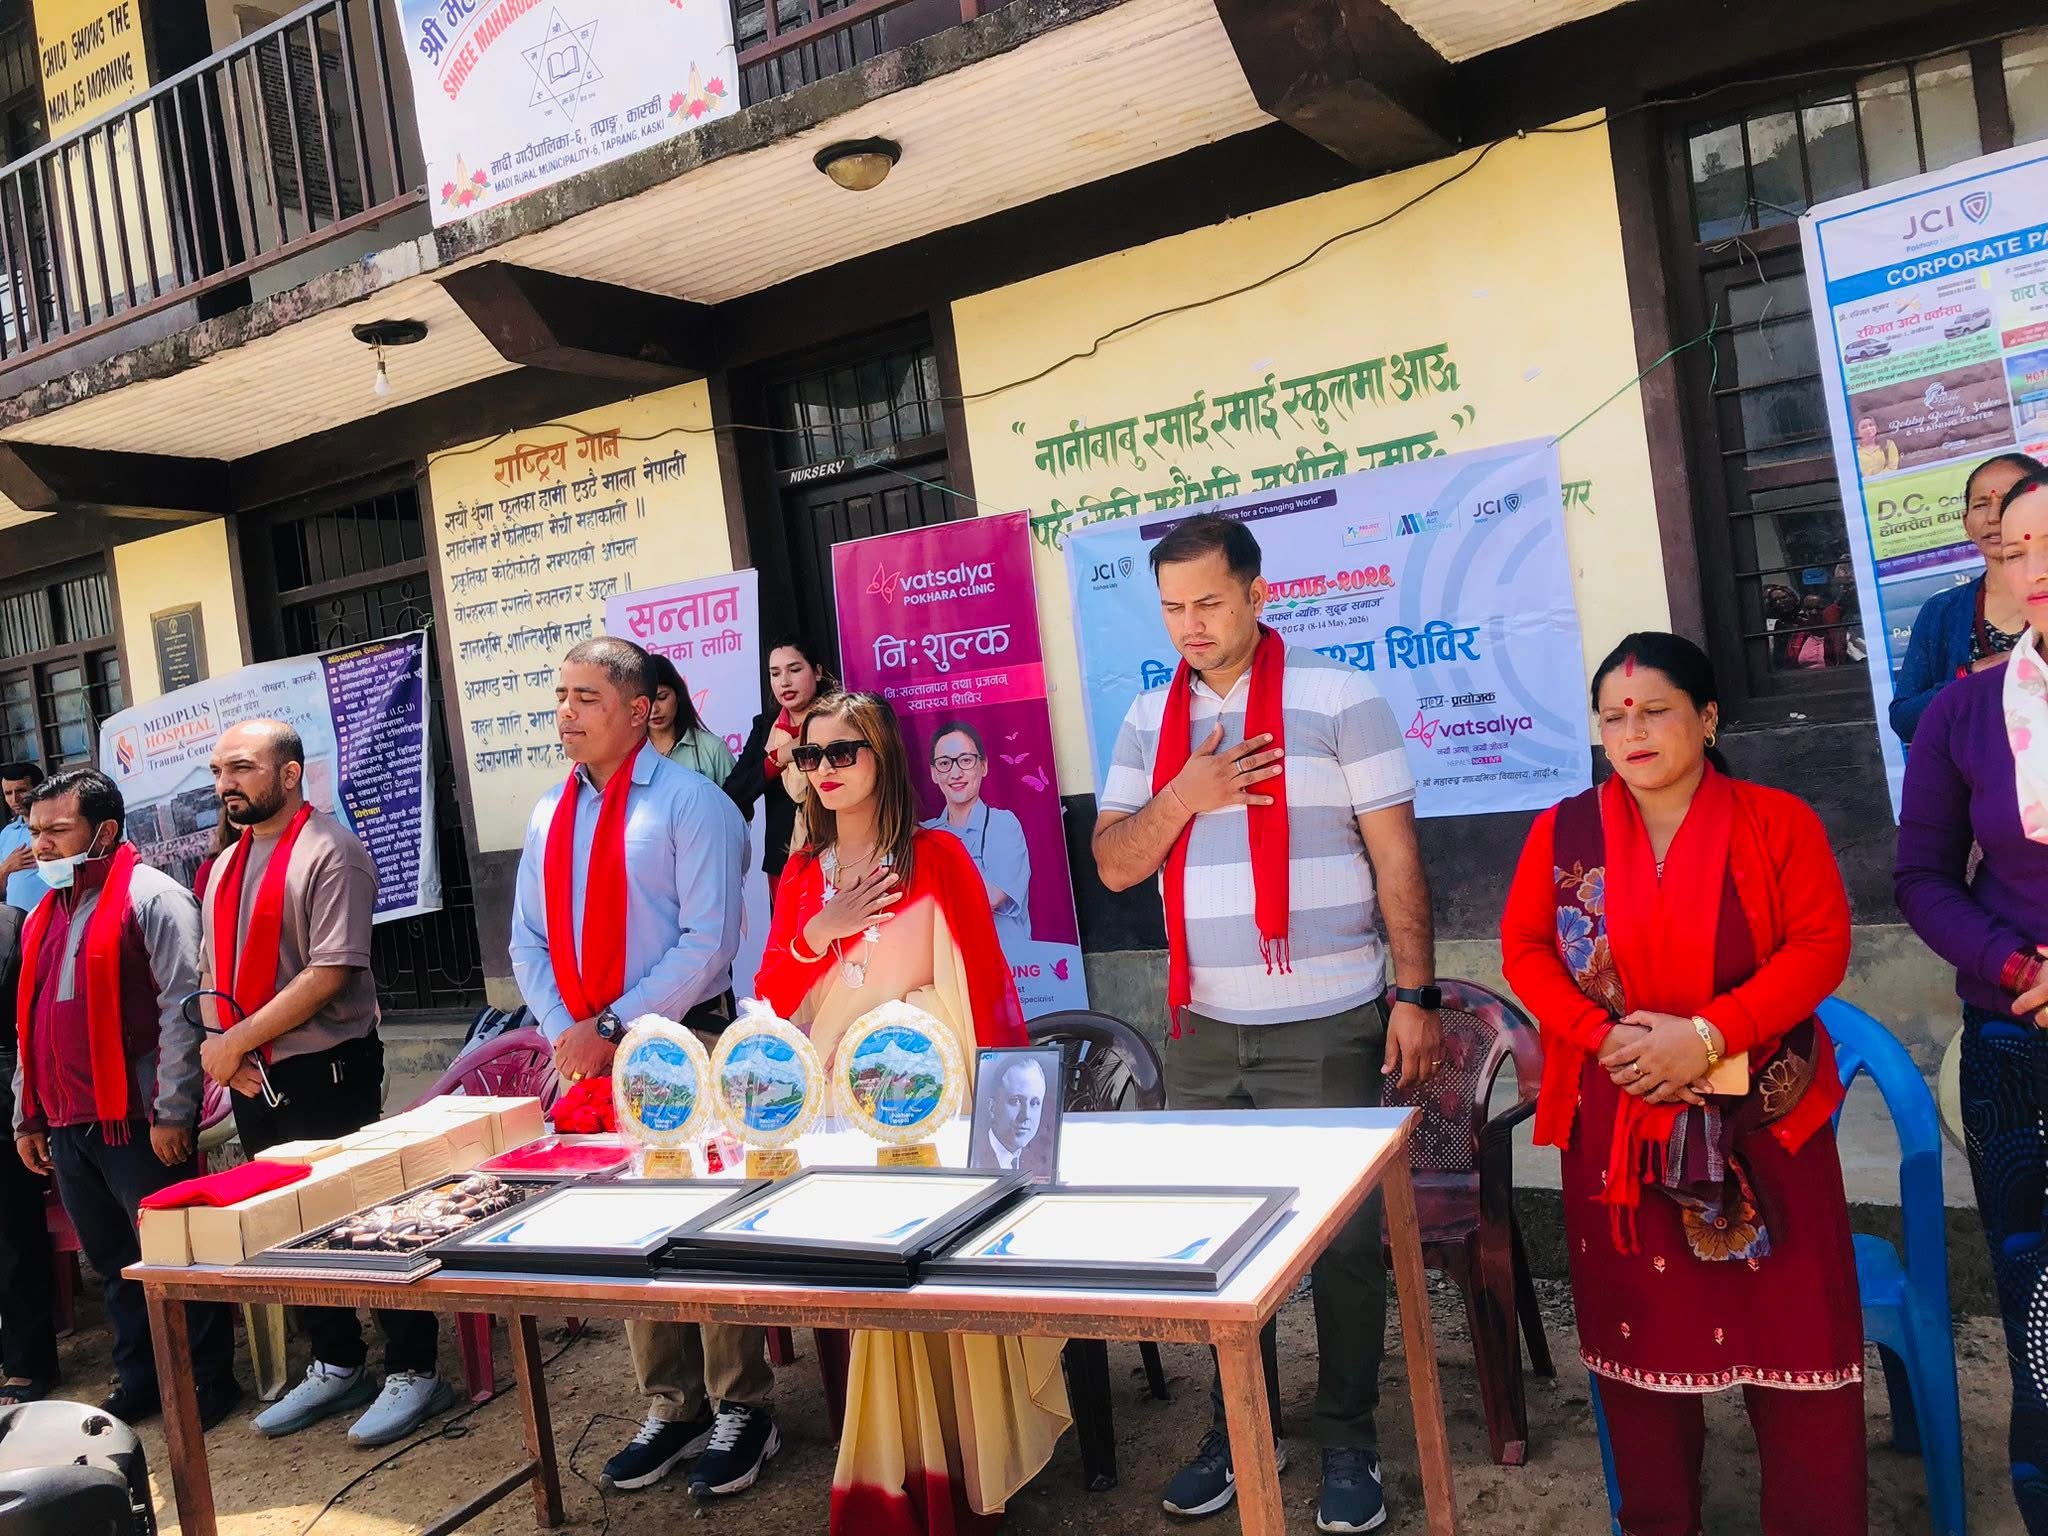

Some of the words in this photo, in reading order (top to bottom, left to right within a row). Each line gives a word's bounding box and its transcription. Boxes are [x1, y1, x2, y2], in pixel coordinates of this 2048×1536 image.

[71, 17, 105, 60] SHOWS
[107, 1, 131, 37] THE
[73, 80, 86, 114] AS
[86, 51, 133, 102] MORNING
[443, 40, 479, 101] SHREE
[494, 180, 513, 192] MADI
[513, 169, 538, 186] RURAL
[641, 119, 665, 137] KASKI
[1902, 206, 1955, 240] JCI
[1887, 236, 2021, 286] CORPORATE
[1914, 420, 1958, 434] TRAINING
[1960, 410, 1994, 422] CENTER
[576, 427, 621, 462] गान
[601, 466, 636, 492] माला
[643, 449, 687, 484] नेपाली
[789, 460, 845, 483] NURSERY
[576, 498, 627, 530] महाकाली
[1240, 509, 1251, 518] for
[1258, 501, 1295, 515] Changing
[1473, 499, 1501, 518] JCI
[900, 561, 992, 593] vatsalya
[1091, 564, 1115, 582] JCI
[903, 588, 957, 606] POKHARA
[959, 582, 996, 597] CLINIC
[625, 586, 740, 638] सन्तान
[701, 628, 743, 657] लागि
[1385, 620, 1480, 669] शिविर
[143, 701, 210, 736] MEDIPLUS
[145, 717, 215, 749] HOSPITAL
[1439, 714, 1533, 738] vatsalya
[148, 752, 185, 771] Trauma
[177, 741, 186, 750] &
